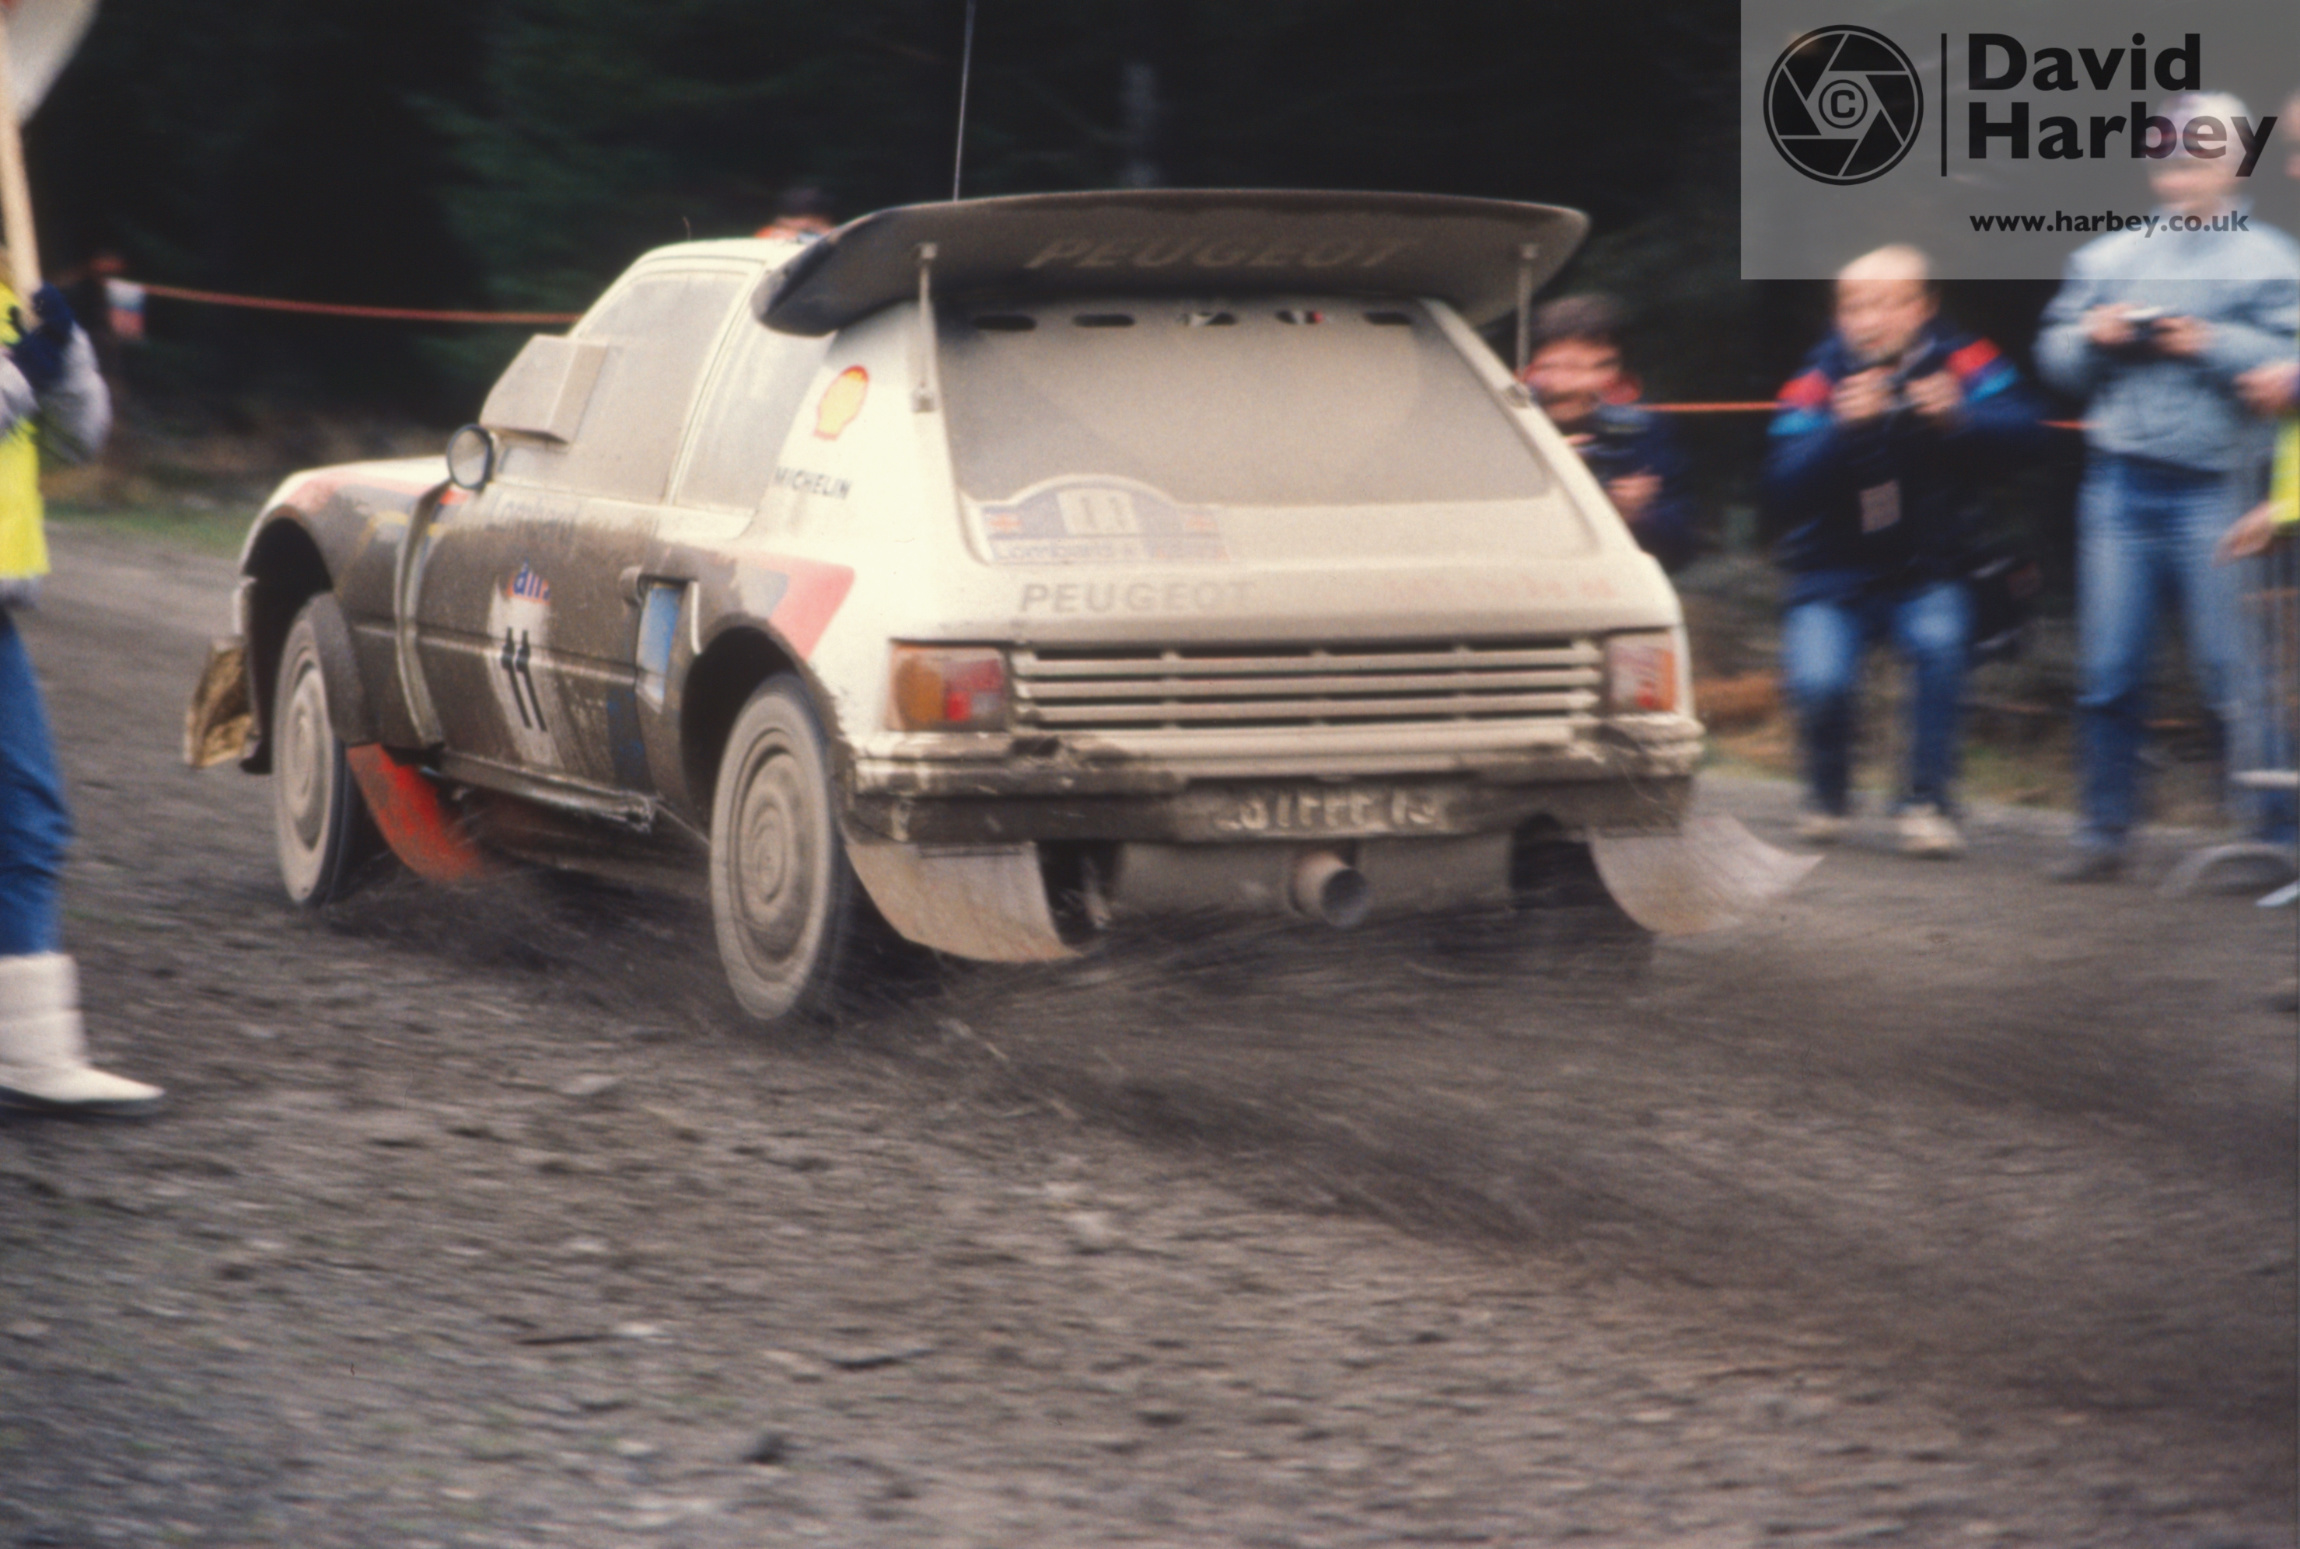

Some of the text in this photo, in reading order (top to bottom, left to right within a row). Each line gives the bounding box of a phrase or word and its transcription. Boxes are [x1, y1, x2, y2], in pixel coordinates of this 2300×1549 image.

[1023, 236, 1417, 270] PEUGEOT
[775, 466, 851, 500] MICHELIN
[1018, 581, 1257, 613] PEUGEOT
[501, 626, 548, 733] 11
